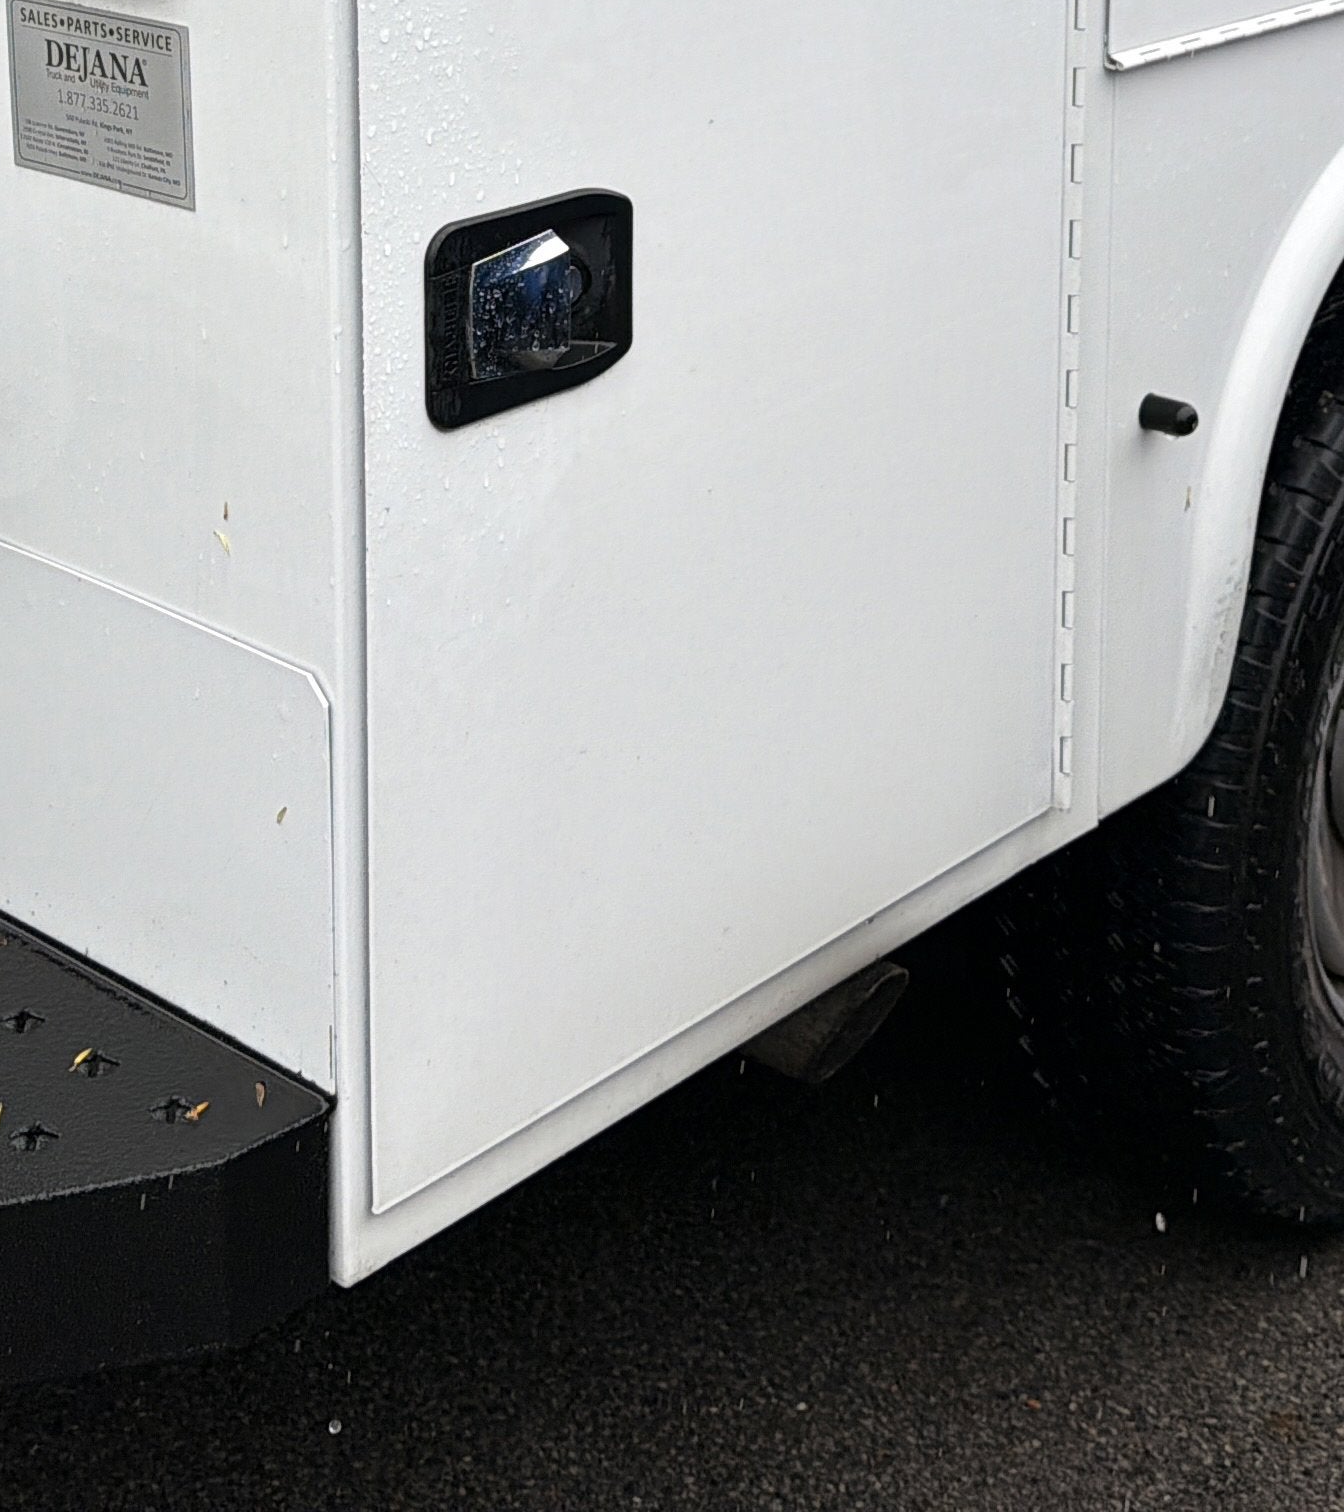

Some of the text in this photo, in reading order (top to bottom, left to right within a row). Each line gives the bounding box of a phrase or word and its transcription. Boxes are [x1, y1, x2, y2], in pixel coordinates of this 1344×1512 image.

[20, 7, 172, 52] SALES PARTS SERVICE
[44, 38, 148, 87] DEJANA
[46, 68, 63, 80] Truck
[64, 73, 76, 83] and
[111, 82, 149, 100] Equipment
[57, 89, 139, 121] 1.877.335.2621
